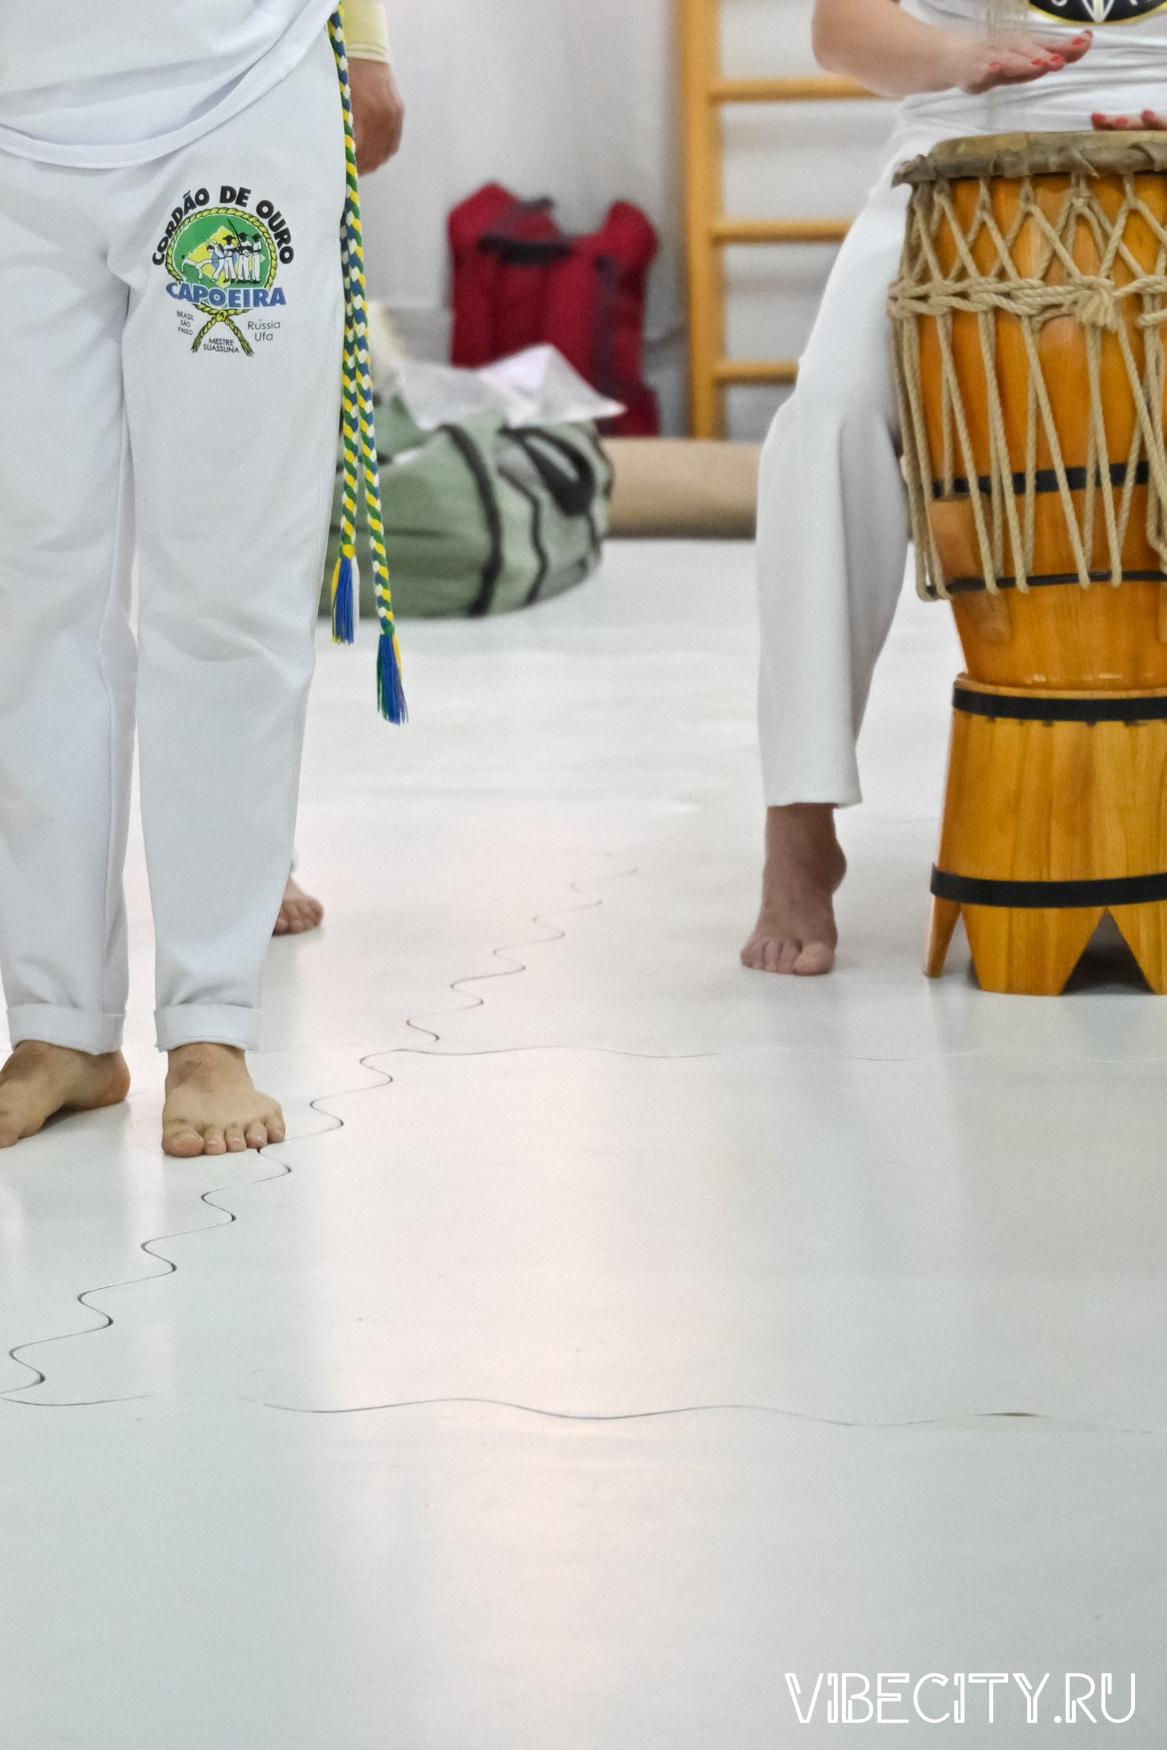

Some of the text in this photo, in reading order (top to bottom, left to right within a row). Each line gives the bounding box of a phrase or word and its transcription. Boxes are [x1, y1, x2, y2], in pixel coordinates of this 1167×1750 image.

[152, 185, 295, 266] CORDÃO DE OURO
[165, 281, 287, 309] CAPOEIRA
[247, 319, 281, 331] Rússia
[208, 338, 235, 347] MESTRE
[254, 332, 274, 342] Ufa
[203, 343, 240, 354] SUASSUNA
